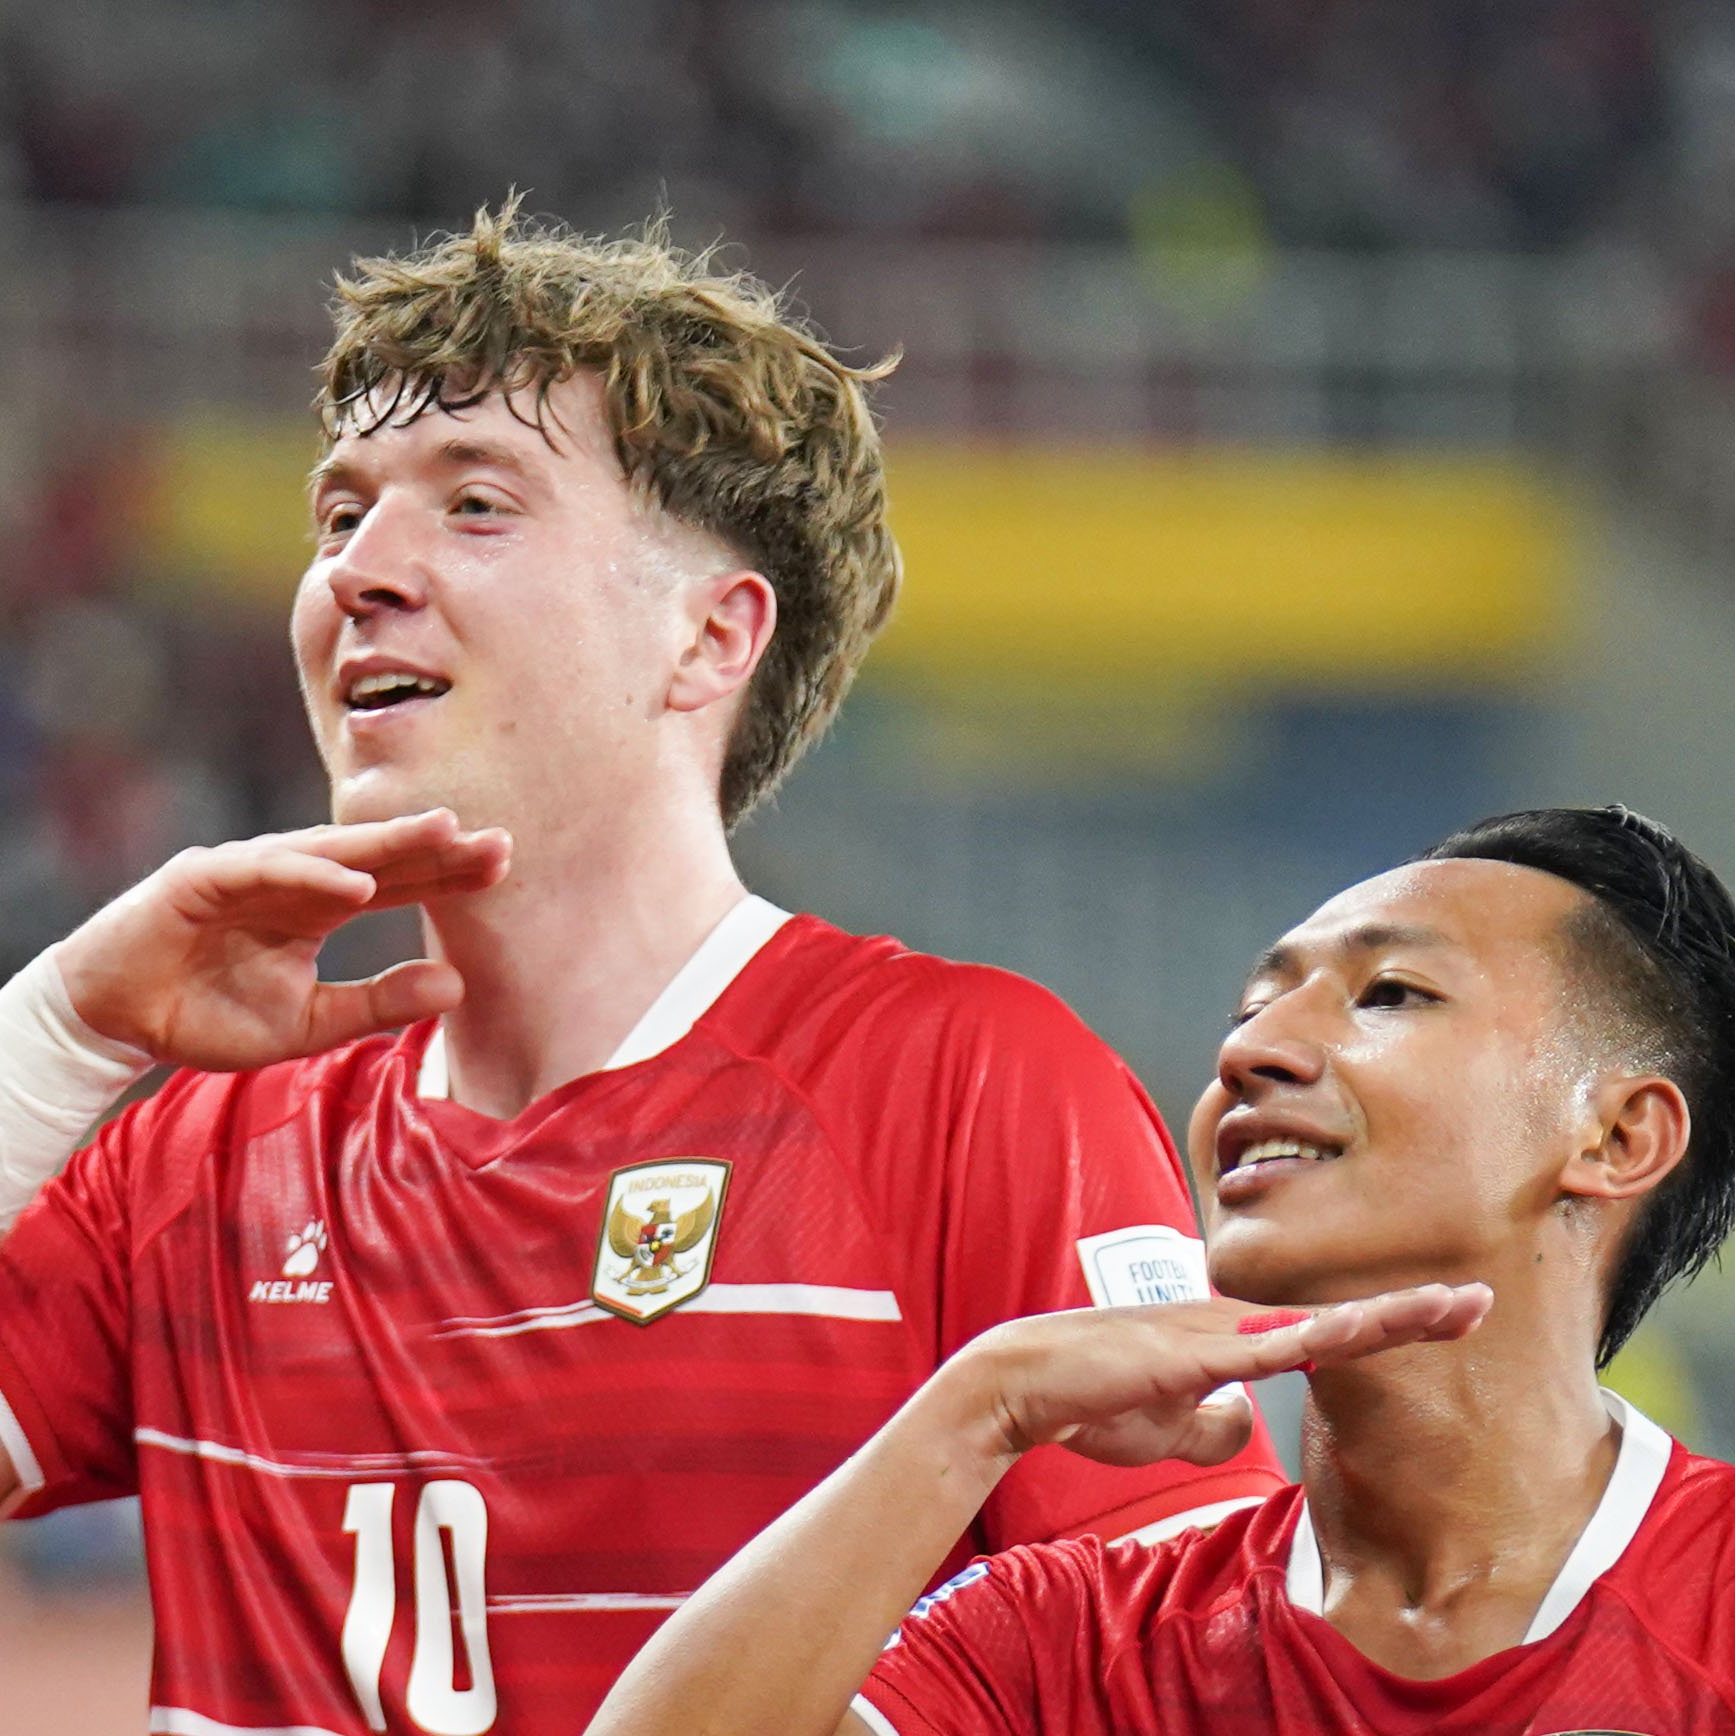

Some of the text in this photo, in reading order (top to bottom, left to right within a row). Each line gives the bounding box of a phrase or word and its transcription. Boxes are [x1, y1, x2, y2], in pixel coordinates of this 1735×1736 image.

[628, 1174, 707, 1193] INDONESIA
[248, 1280, 334, 1303] KELME
[1136, 1284, 1194, 1304] UNIT
